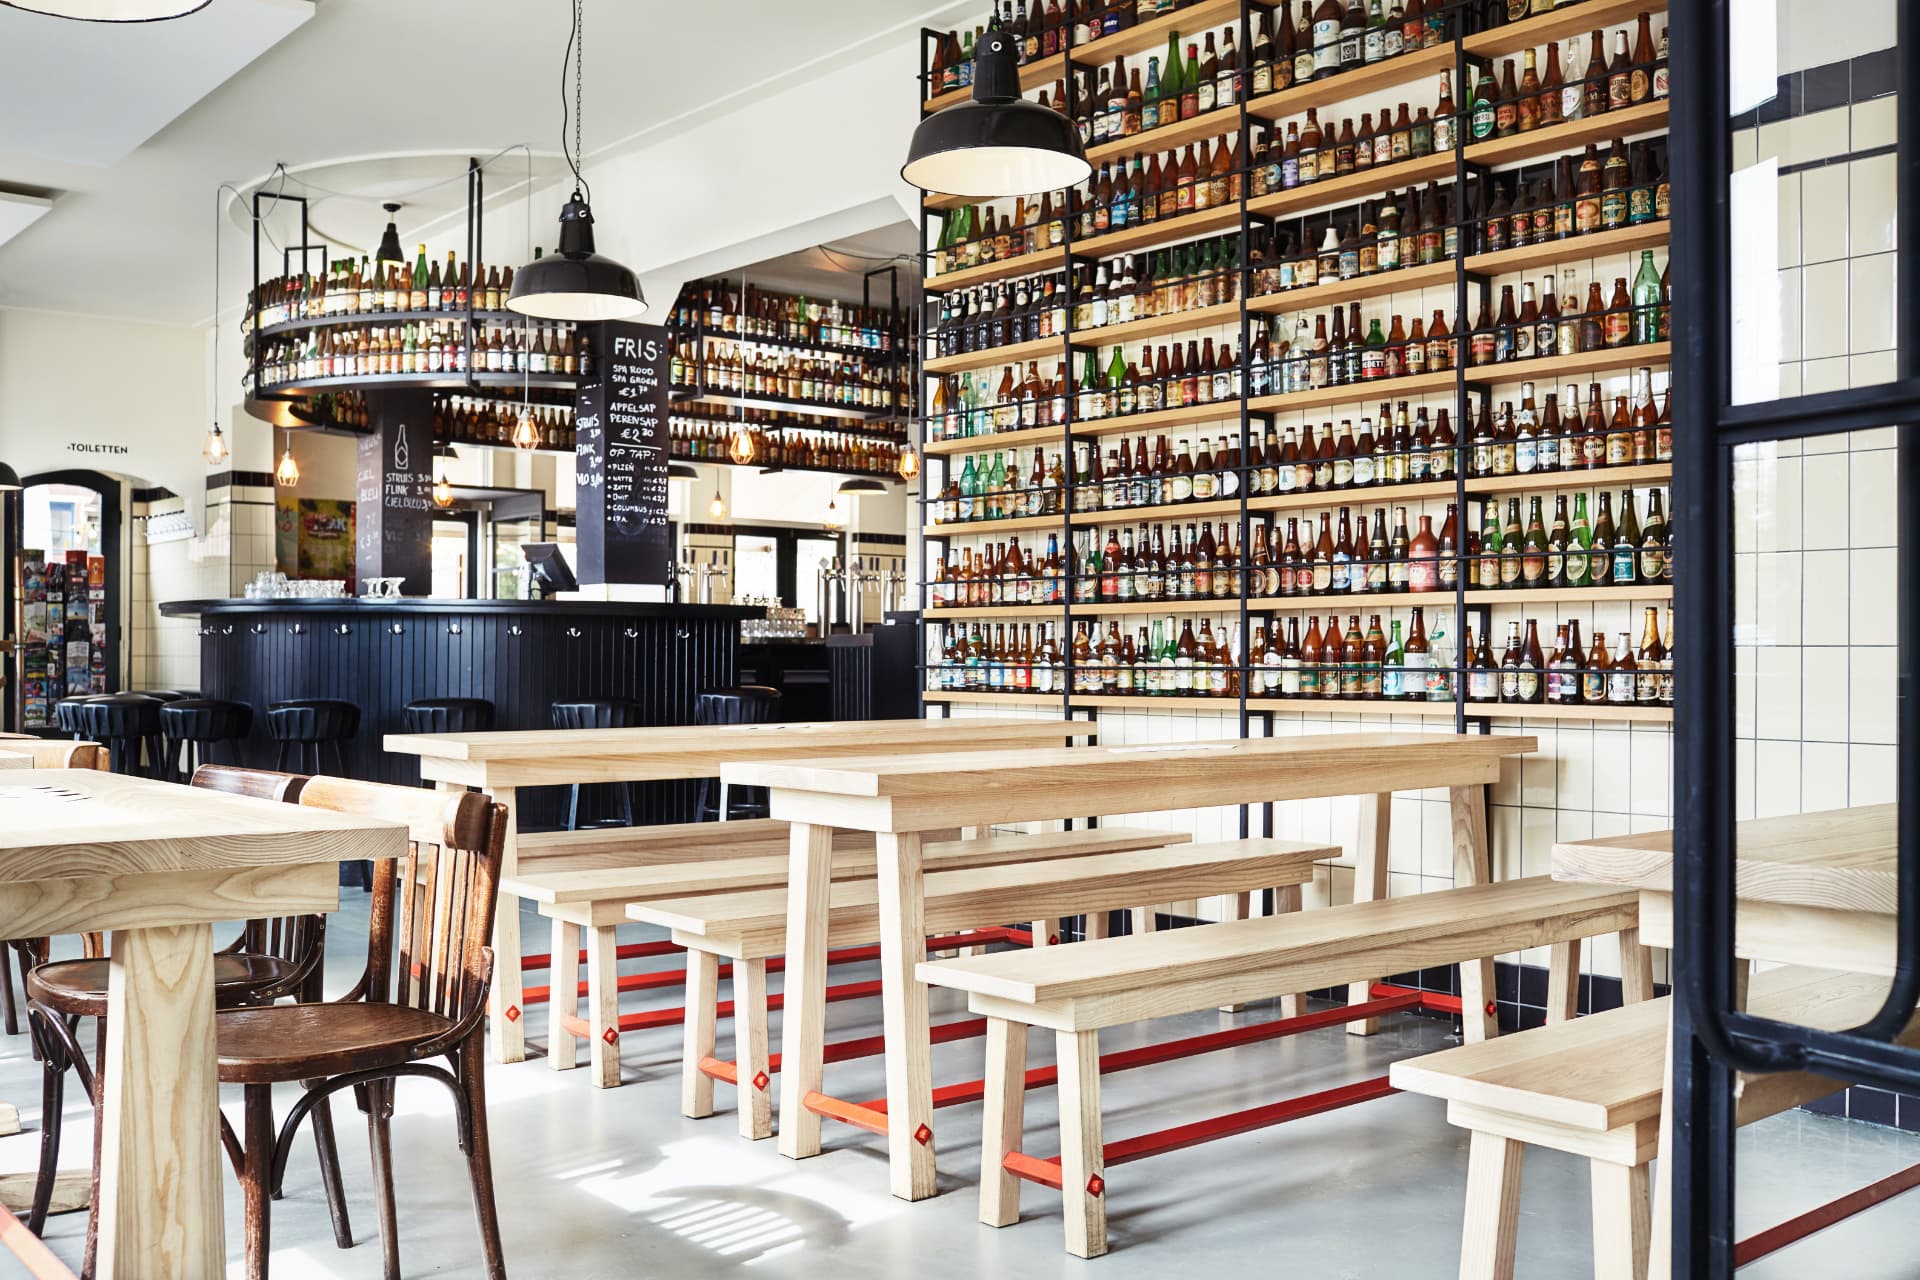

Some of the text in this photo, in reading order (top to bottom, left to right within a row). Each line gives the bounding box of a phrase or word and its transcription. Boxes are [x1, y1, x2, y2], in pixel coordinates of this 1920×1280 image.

[614, 337, 663, 361] FRIS:
[613, 364, 654, 376] SPA ROOD
[612, 374, 658, 386] SPA GROEN
[610, 401, 656, 413] APPELSAP
[609, 413, 659, 428] PERENSAP
[71, 442, 128, 454] TOILETTEN
[609, 448, 656, 461] OP TAP:
[386, 473, 414, 483] STRUIS
[612, 504, 647, 513] COLUMBUS
